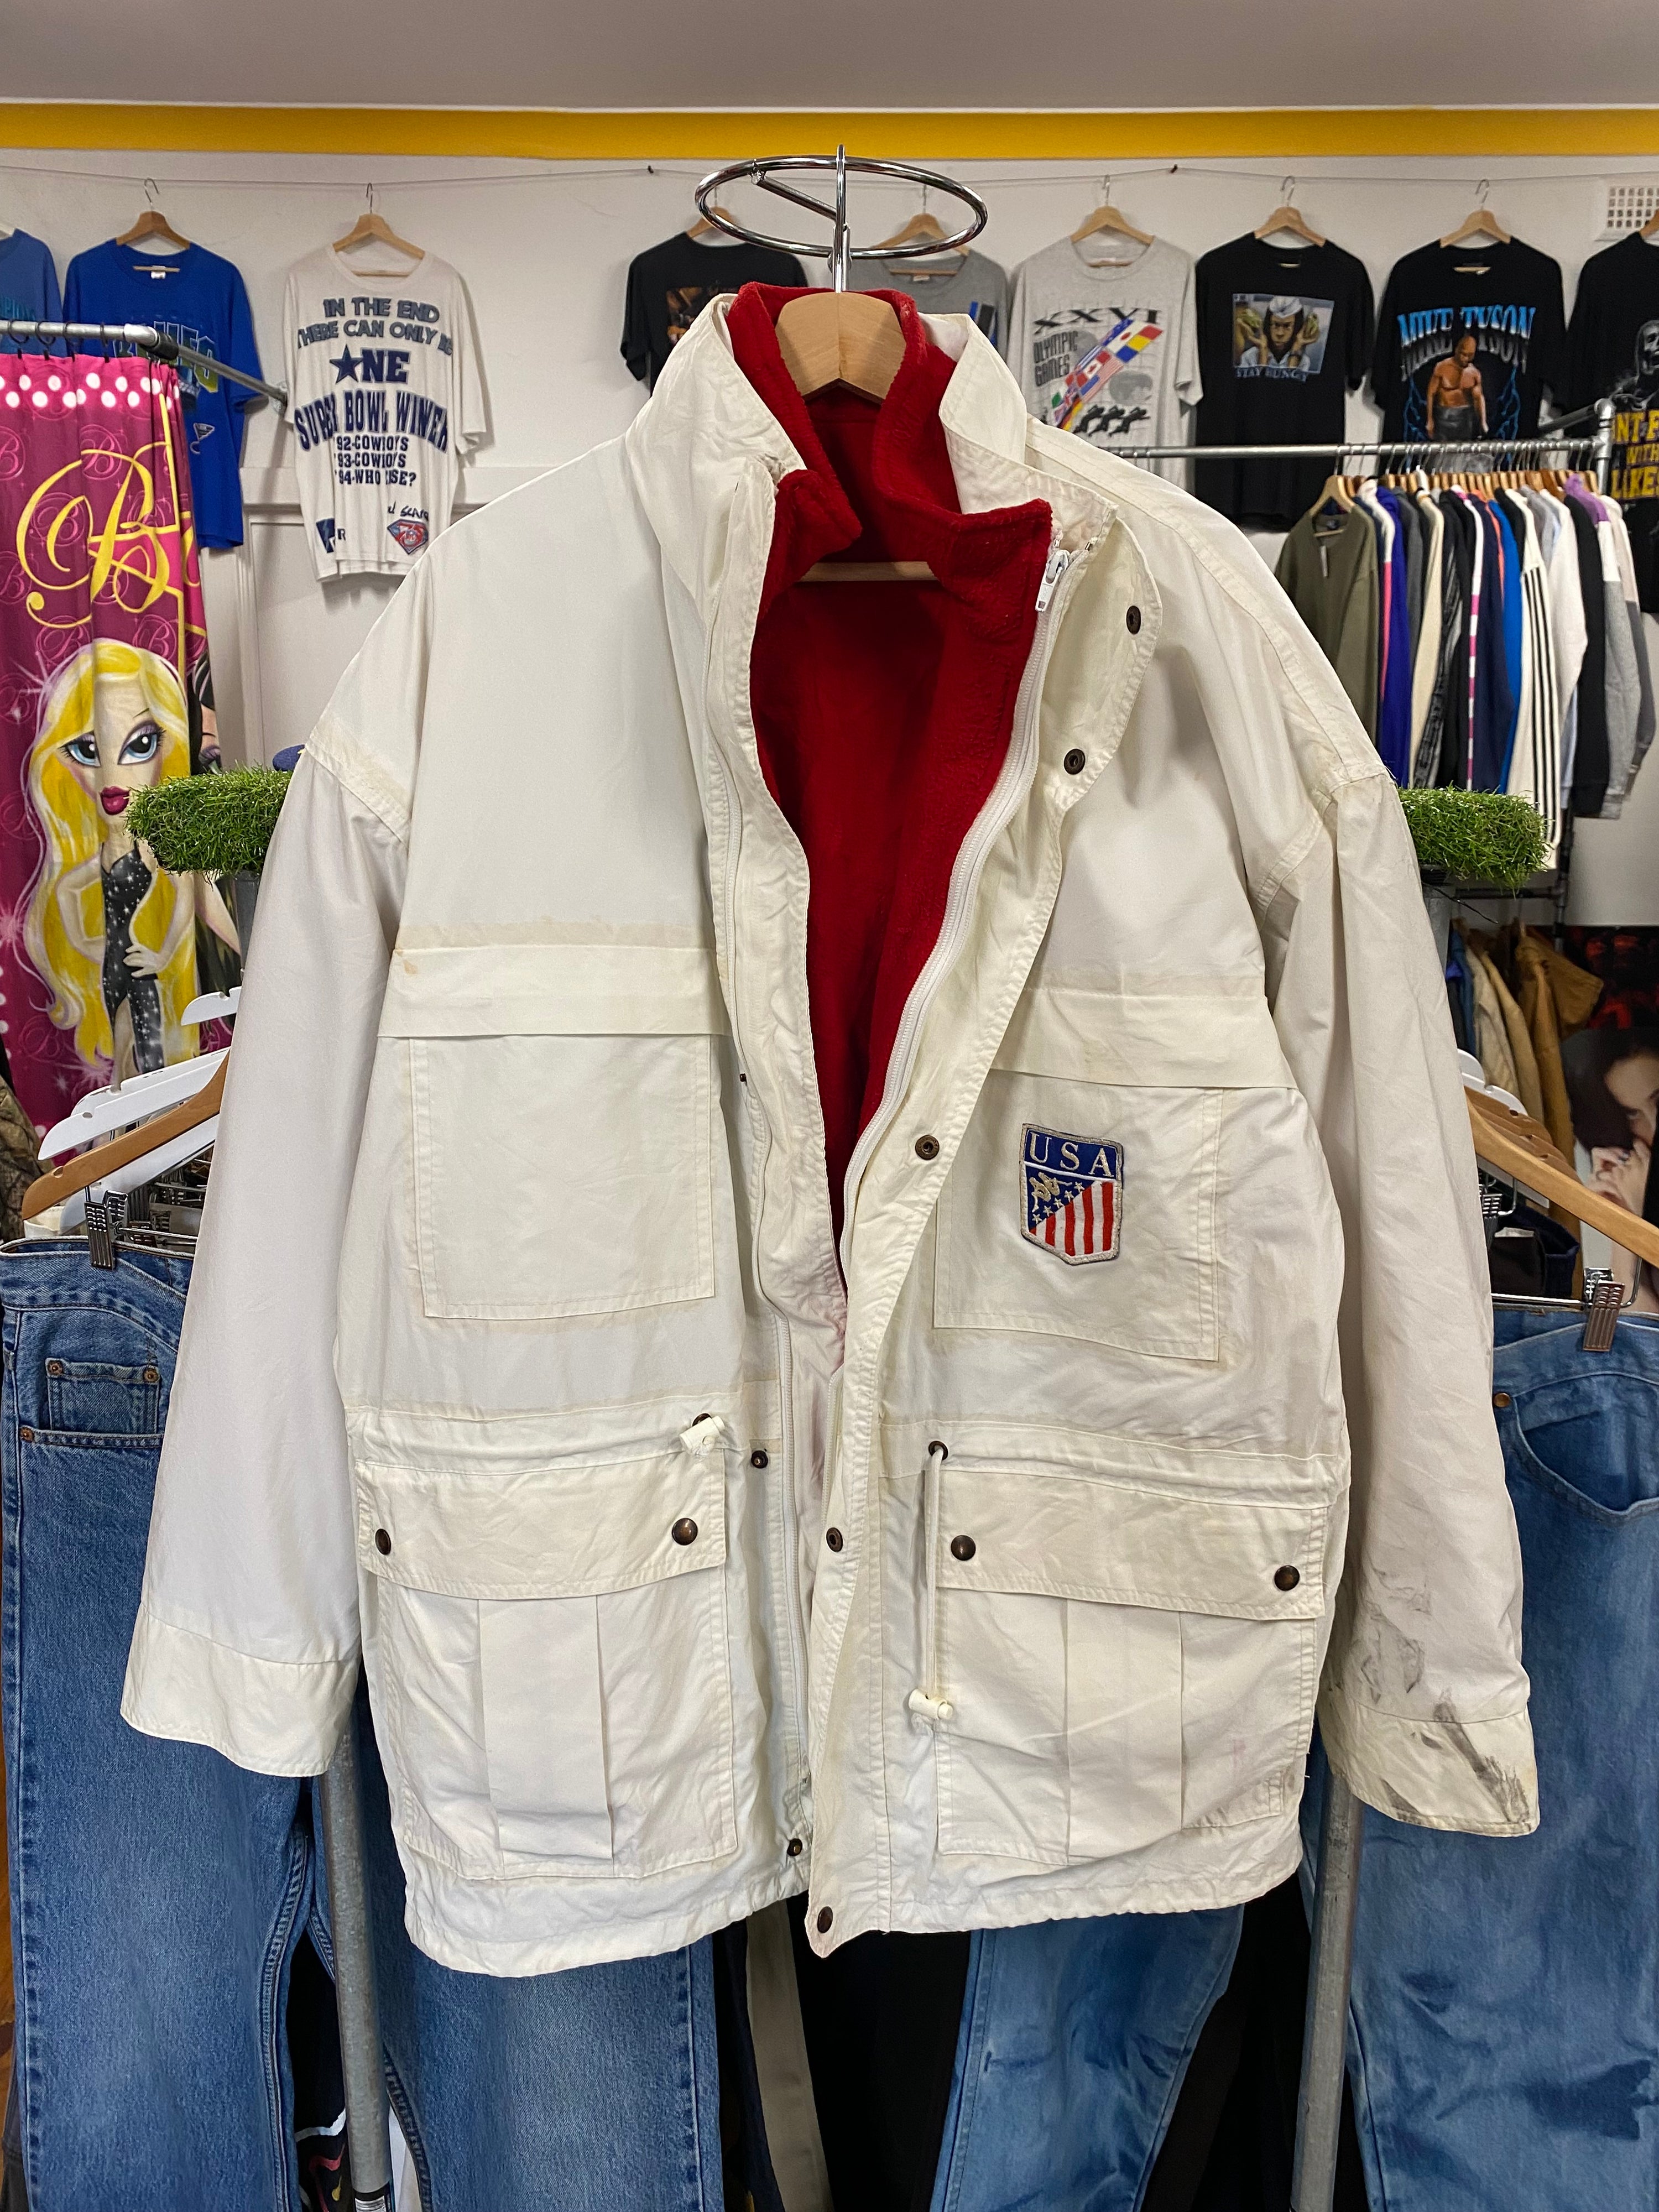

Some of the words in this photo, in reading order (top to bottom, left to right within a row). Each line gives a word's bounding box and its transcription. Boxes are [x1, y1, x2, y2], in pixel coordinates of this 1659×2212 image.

[322, 298, 345, 318] IN
[351, 296, 392, 317] THE
[397, 300, 440, 323] END
[1033, 306, 1160, 334] XXVI
[1459, 304, 1536, 339] TYSON
[343, 320, 384, 337] CAN
[389, 321, 438, 345] ONLY
[1034, 331, 1078, 363] OLYMPIC
[1035, 354, 1070, 387] GAMES
[343, 388, 389, 433] BOWL
[333, 434, 409, 451] '92-COWOYS
[333, 452, 406, 468] '93-COWOYS
[1029, 1131, 1114, 1178] USA
